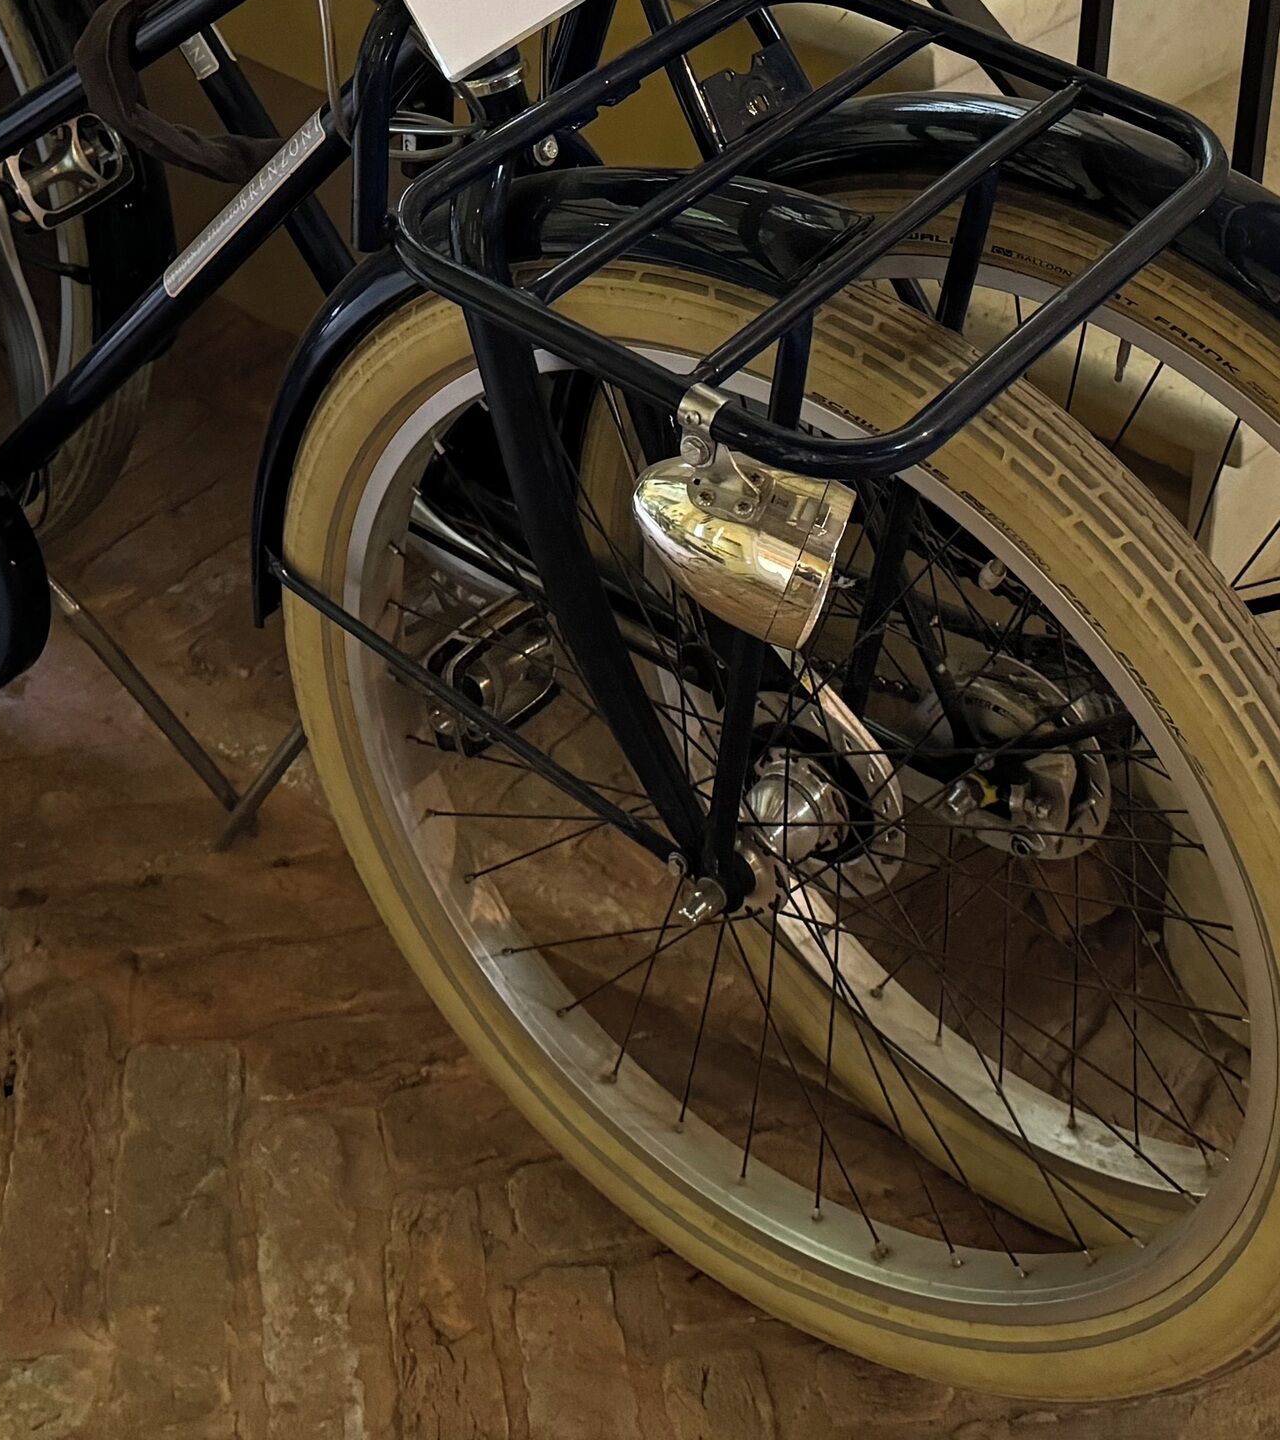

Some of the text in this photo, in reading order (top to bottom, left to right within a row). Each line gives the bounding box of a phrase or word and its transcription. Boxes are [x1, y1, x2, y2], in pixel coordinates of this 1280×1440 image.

[1016, 252, 1073, 277] BALLOON
[1154, 316, 1241, 375] FRANK
[1058, 583, 1189, 744] FAT FRANK
